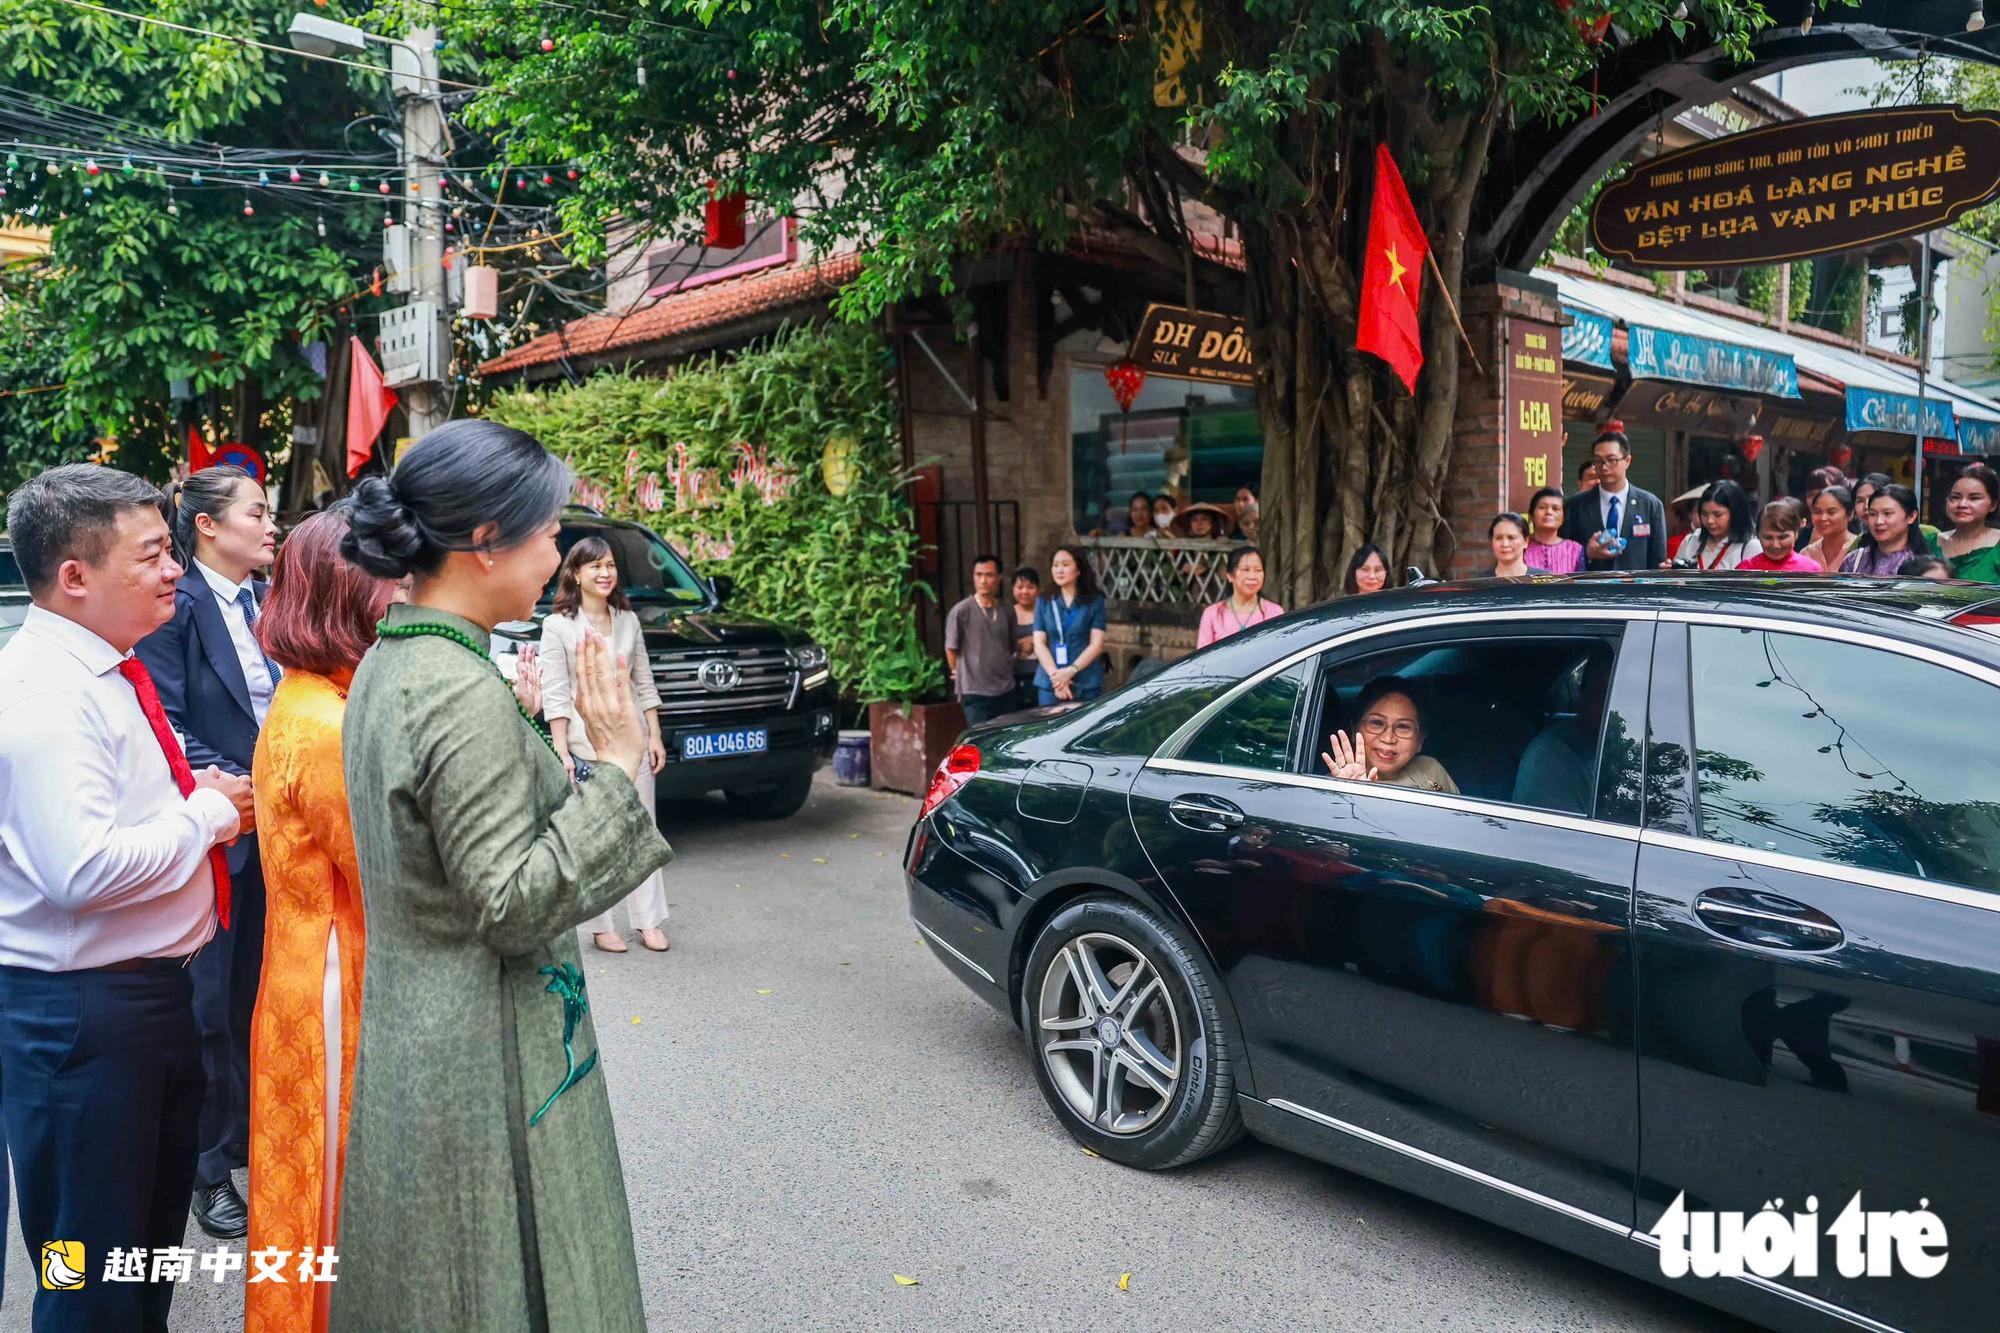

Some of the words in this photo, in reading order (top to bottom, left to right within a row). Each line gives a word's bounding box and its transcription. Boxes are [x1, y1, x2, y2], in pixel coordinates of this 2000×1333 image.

[1624, 200, 1680, 223] VĂN
[1689, 184, 1754, 213] HOÁ
[1766, 171, 1852, 201] LÀNG
[1866, 145, 1967, 185] NGHỀ
[1714, 159, 1745, 175] SÁNG
[1701, 215, 1759, 239] LỤA
[1770, 203, 1836, 228] VẠN
[1850, 186, 1943, 217] PHÚC
[1520, 400, 1552, 438] LỤA
[1524, 453, 1548, 487] TƠ
[686, 731, 765, 755] 80A-046.66
